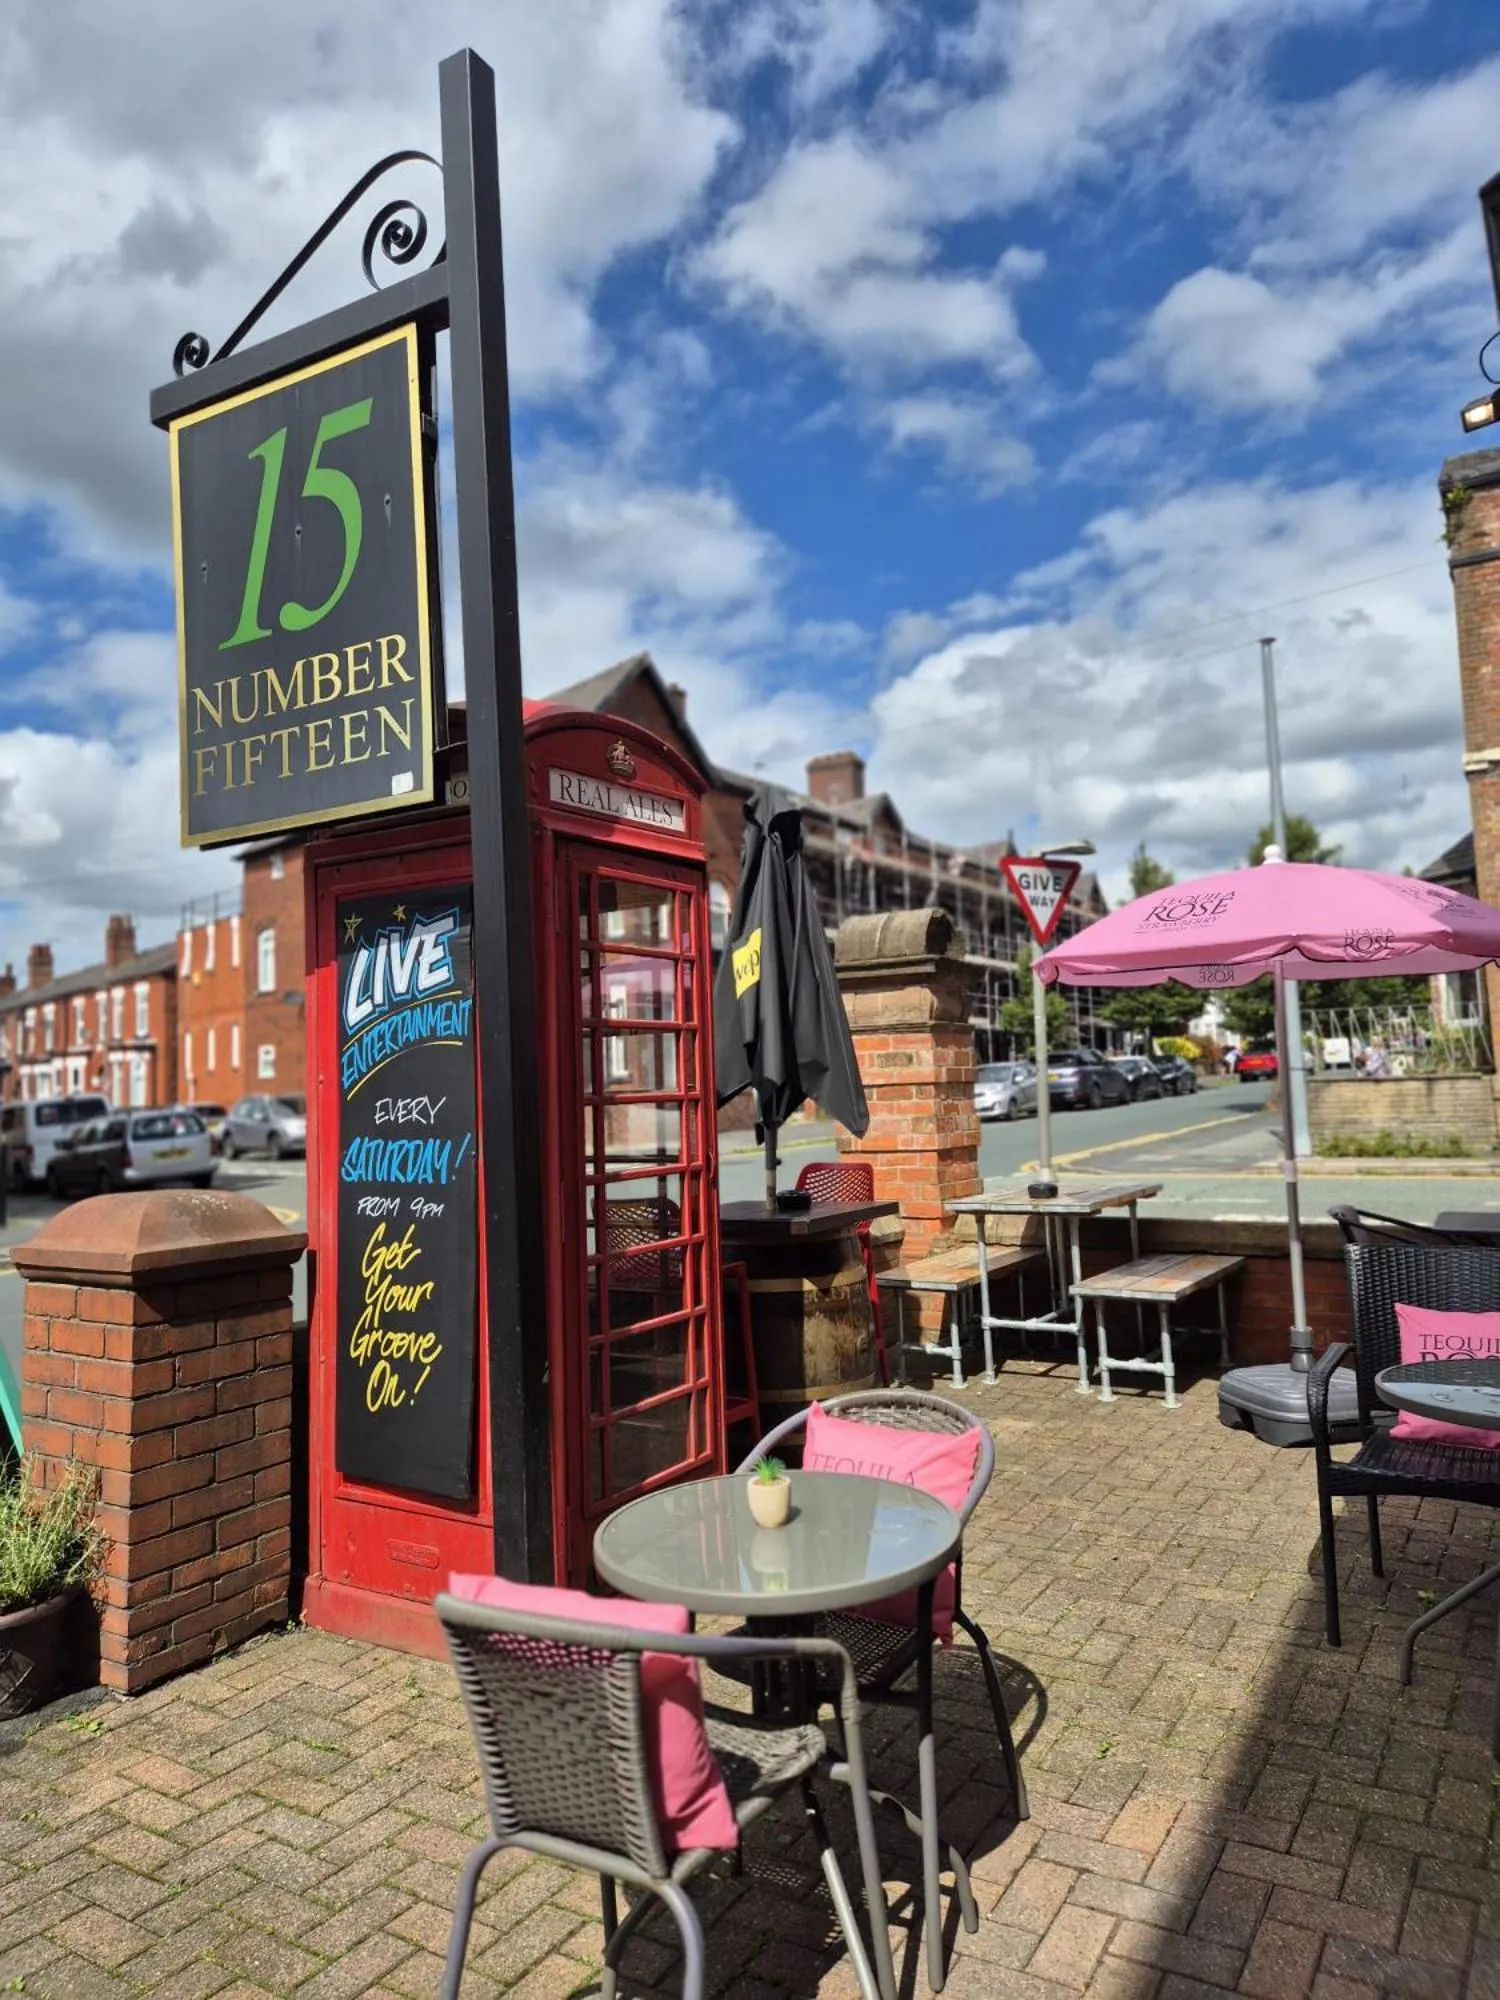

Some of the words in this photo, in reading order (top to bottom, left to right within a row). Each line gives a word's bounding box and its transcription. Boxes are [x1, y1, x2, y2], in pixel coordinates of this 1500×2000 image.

[217, 396, 374, 652] 15
[191, 633, 416, 734] NUMBER
[192, 697, 416, 797] FIFTEEN
[559, 773, 620, 813] REAL
[624, 792, 674, 826] ALES
[1018, 873, 1065, 892] GIVE
[1028, 896, 1056, 908] WAY
[1143, 898, 1229, 922] ROSE
[345, 910, 458, 1031] LIVE
[1343, 935, 1396, 954] ROSE
[341, 996, 473, 1089] ENTERTAINMENT
[374, 1095, 447, 1125] EVERY
[341, 1132, 472, 1185] SATURDAY!
[356, 1196, 401, 1217] FROM
[361, 1221, 422, 1287] Get
[365, 1273, 435, 1329] Your
[349, 1304, 443, 1368] Groove
